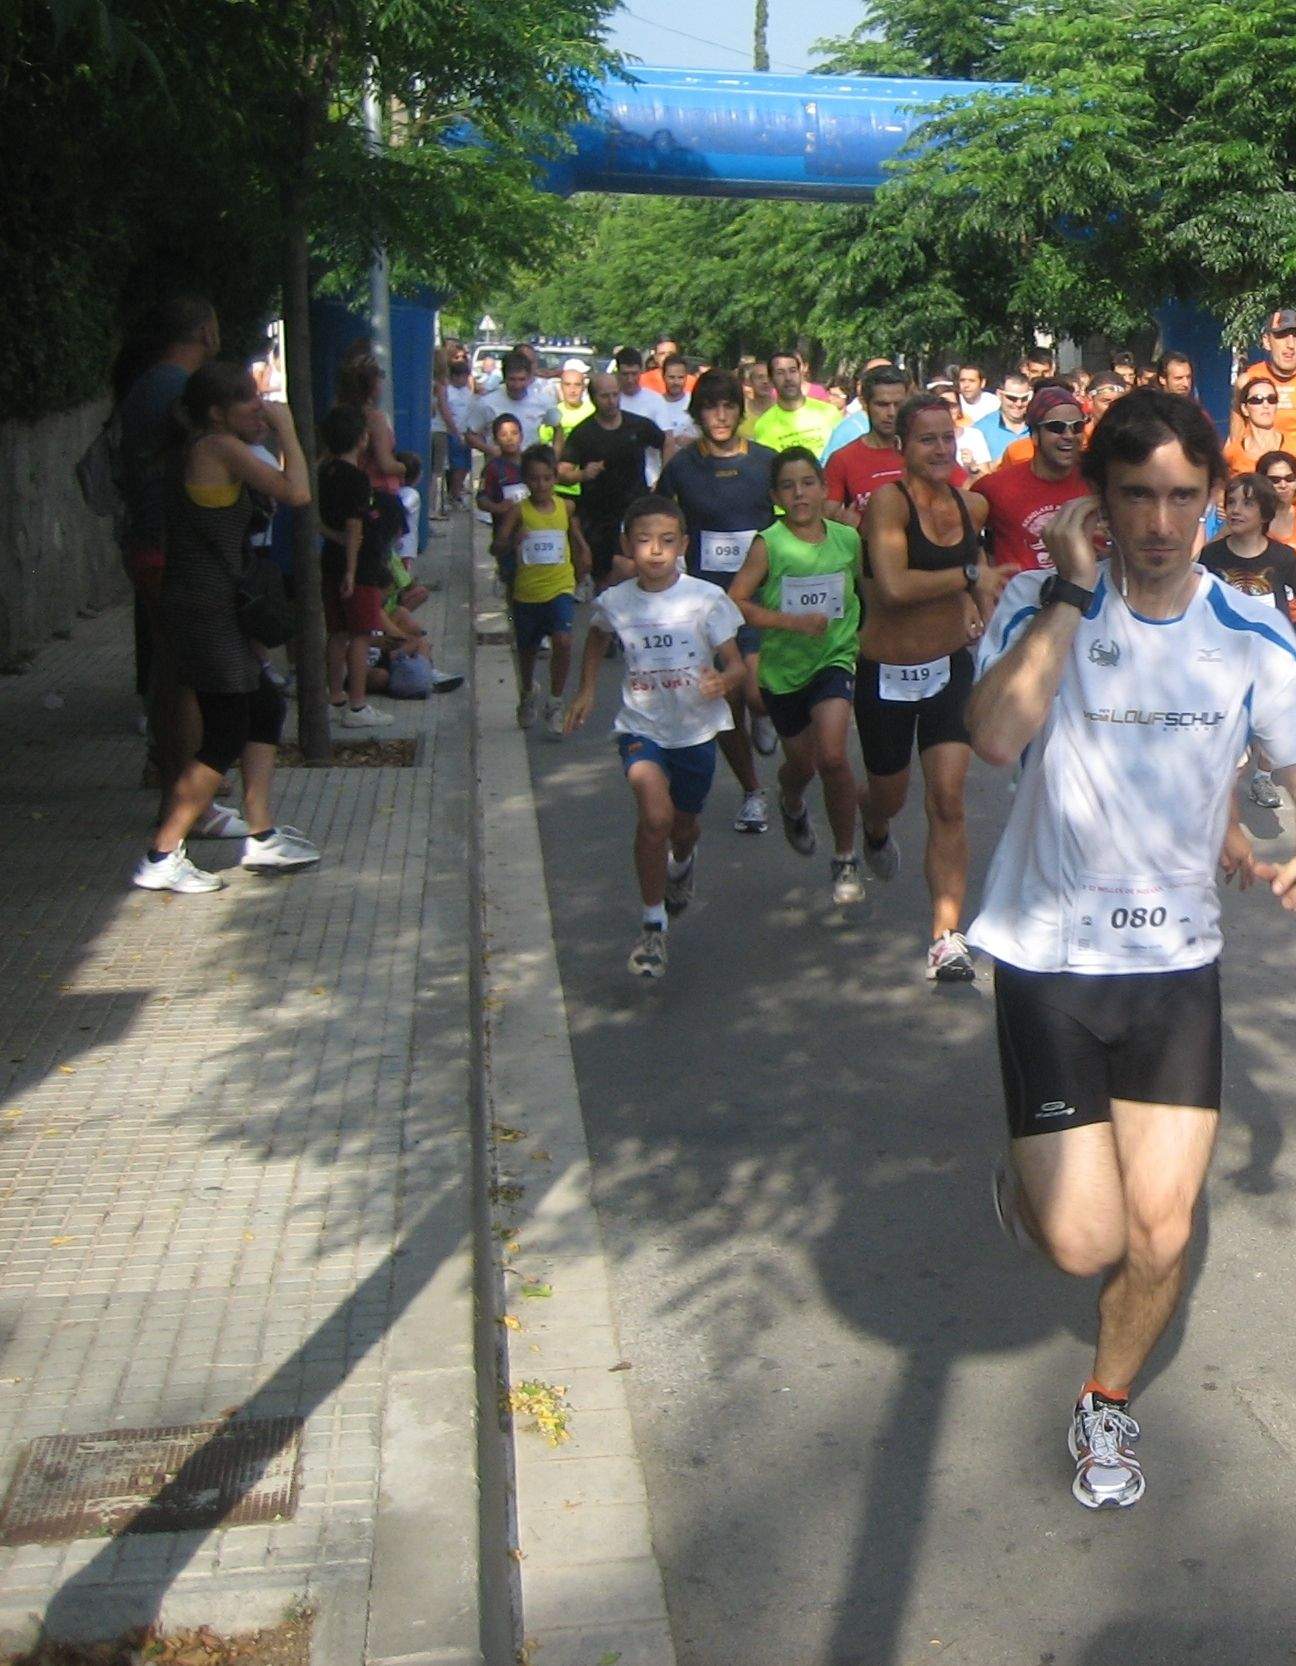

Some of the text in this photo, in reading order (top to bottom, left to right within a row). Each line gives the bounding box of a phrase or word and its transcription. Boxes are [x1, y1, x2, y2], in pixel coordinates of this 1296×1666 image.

[715, 545, 740, 556] 098
[800, 592, 827, 606] 007
[642, 634, 673, 649] 120
[901, 667, 930, 681] 119
[1111, 906, 1167, 929] 080
